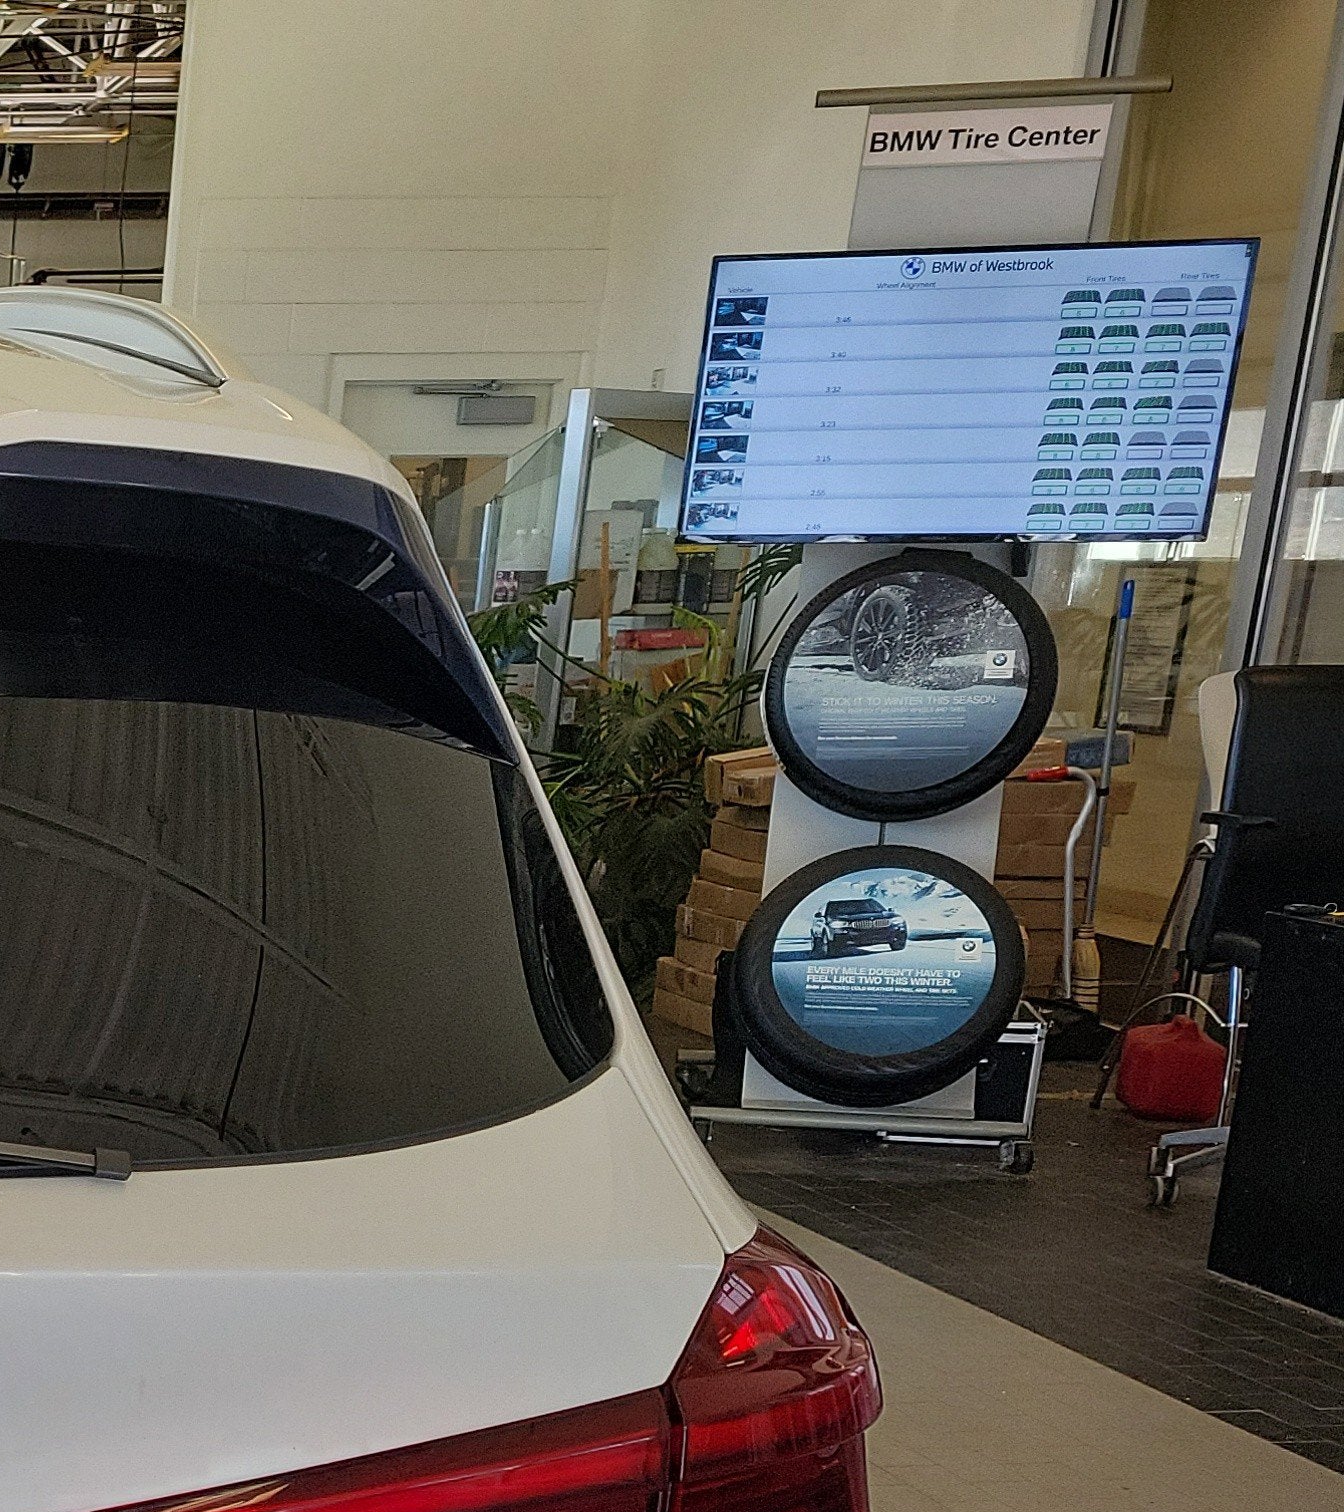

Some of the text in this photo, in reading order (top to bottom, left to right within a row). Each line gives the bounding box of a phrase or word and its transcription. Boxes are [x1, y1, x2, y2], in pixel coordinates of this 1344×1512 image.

[869, 125, 1101, 153] BMW Tire Center
[932, 260, 967, 274] BMW
[969, 259, 984, 273] of
[986, 257, 1055, 272] Westbrook
[822, 697, 851, 707] STICK
[865, 696, 882, 706] TO
[884, 696, 924, 706] WINTER
[928, 695, 951, 705] THIS
[807, 966, 961, 979] EVERY MILE DOESN'T HAVE TO
[806, 974, 832, 983] FEEL
[833, 974, 856, 984] LIKE
[858, 975, 883, 985] TWO
[884, 976, 909, 986] THIS
